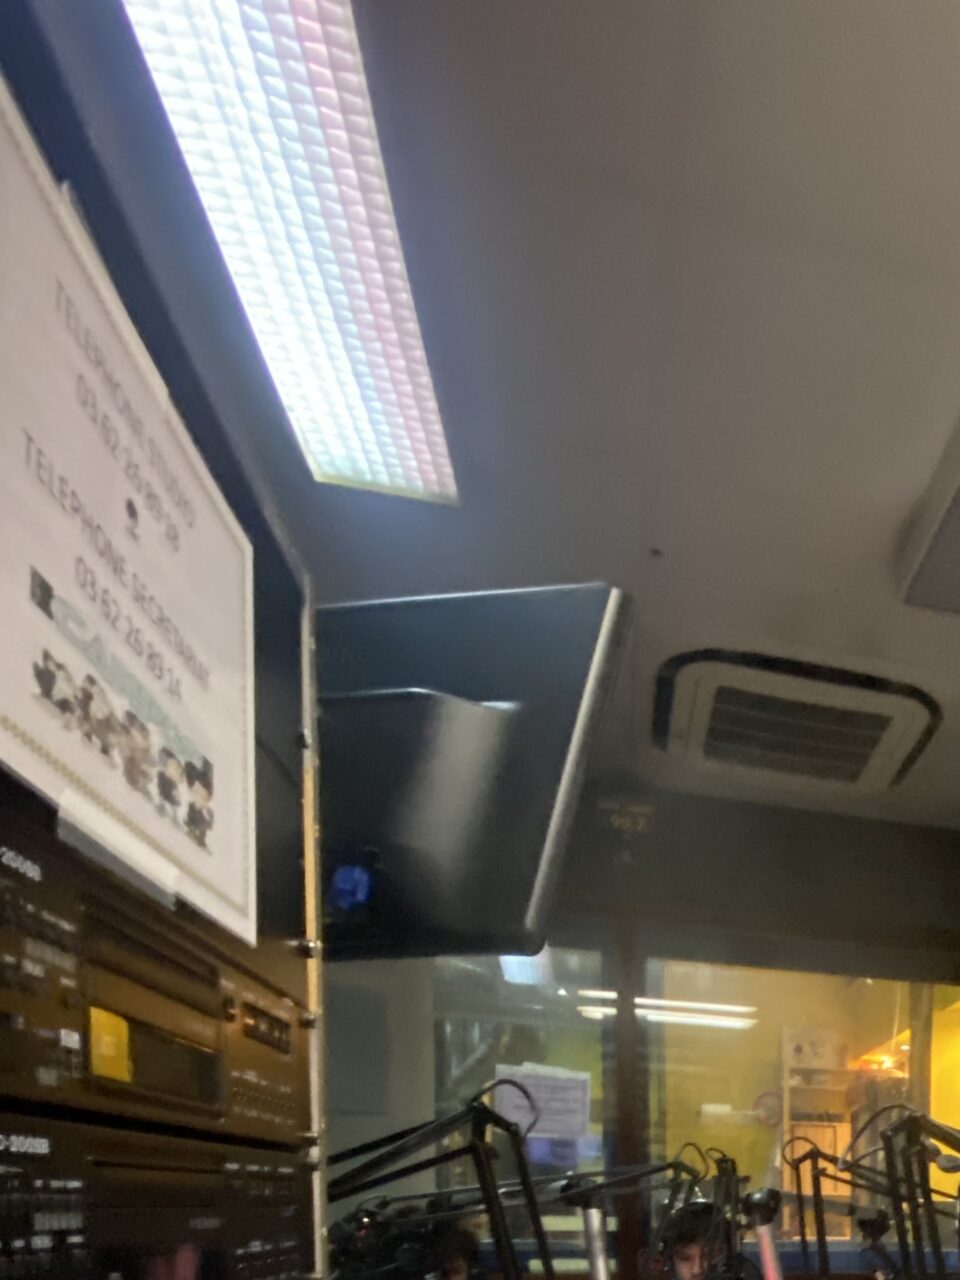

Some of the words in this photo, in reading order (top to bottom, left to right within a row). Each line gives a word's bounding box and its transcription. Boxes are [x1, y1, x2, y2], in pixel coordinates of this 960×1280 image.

[22, 427, 128, 588] TELEPHONE
[75, 555, 97, 603] 03
[101, 587, 120, 633] 62
